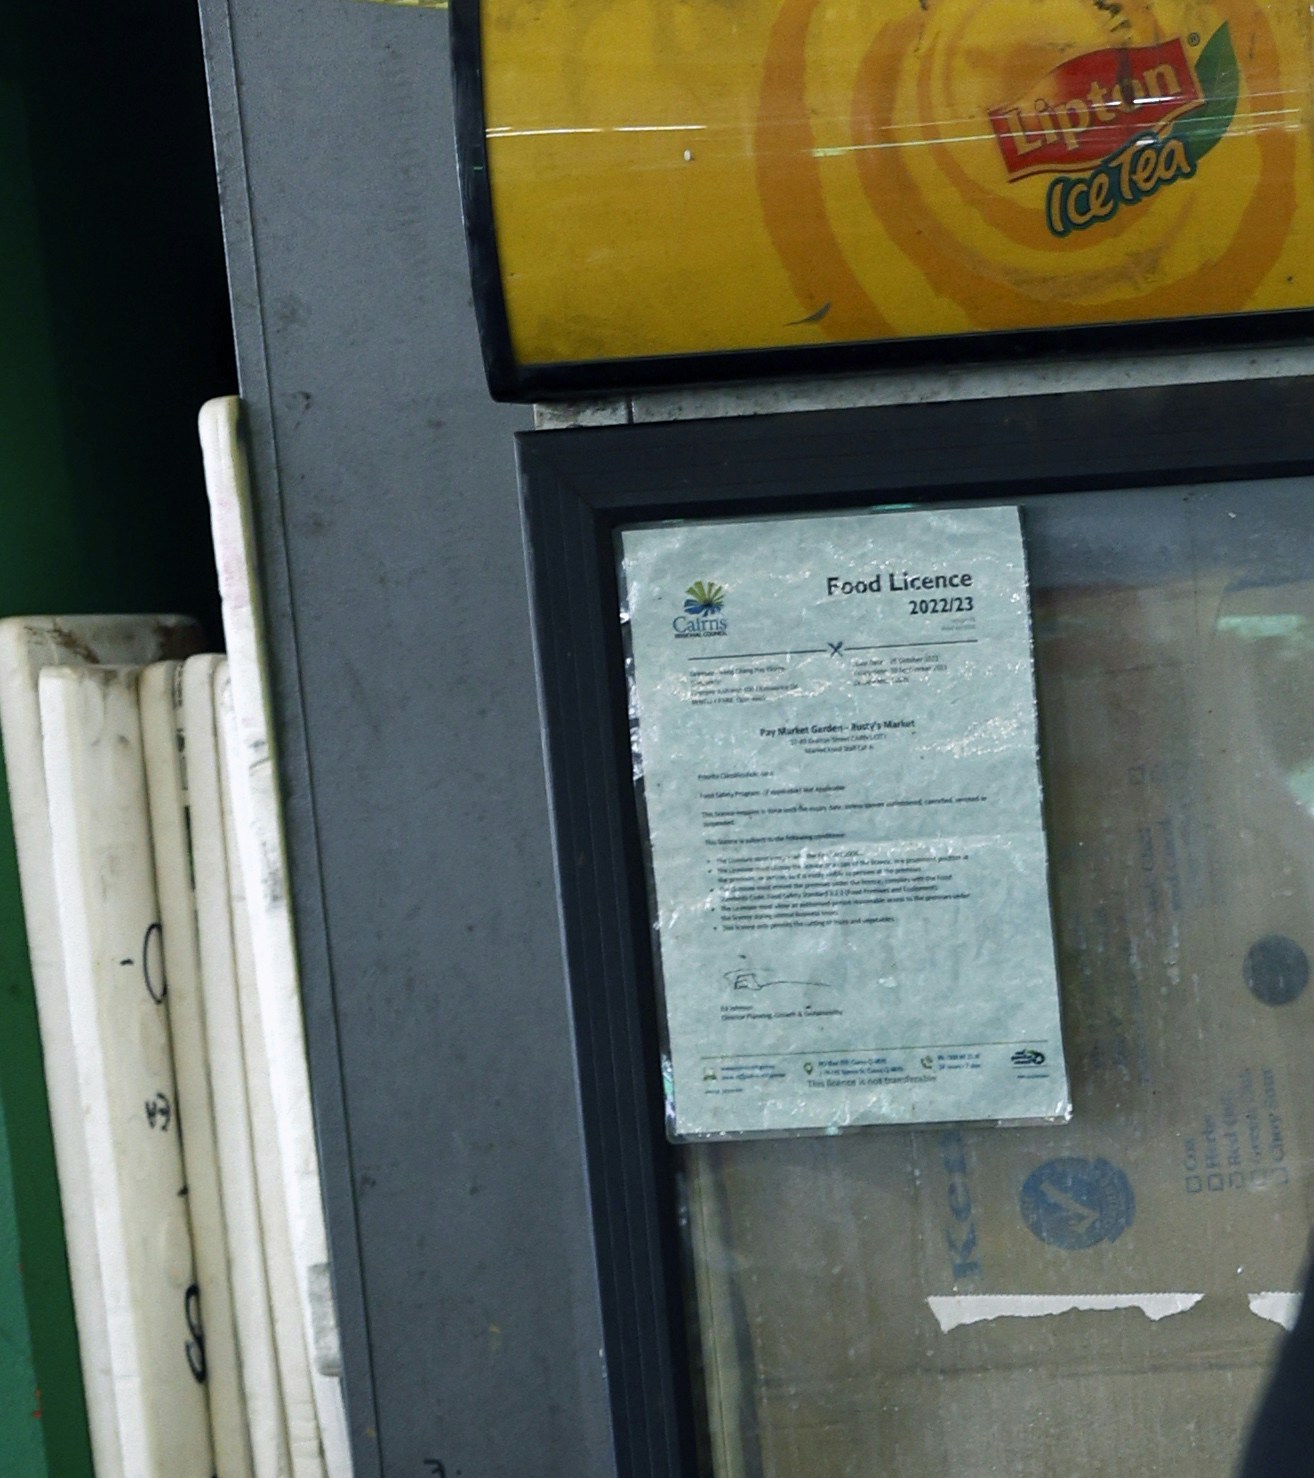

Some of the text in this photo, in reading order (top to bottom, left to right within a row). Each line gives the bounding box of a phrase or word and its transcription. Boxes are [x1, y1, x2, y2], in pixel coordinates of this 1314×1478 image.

[1006, 63, 1182, 156] Lipton
[1050, 138, 1192, 232] Ice Tea
[827, 571, 972, 597] Food Licence
[909, 597, 974, 615] 2022/23
[673, 616, 727, 634] Cairns
[777, 725, 808, 736] Market
[811, 723, 842, 735] Garden
[851, 722, 882, 734] Rusty's
[884, 719, 915, 730] Market
[807, 1079, 825, 1087] This
[826, 1078, 856, 1087] licence
[867, 1077, 882, 1085] not
